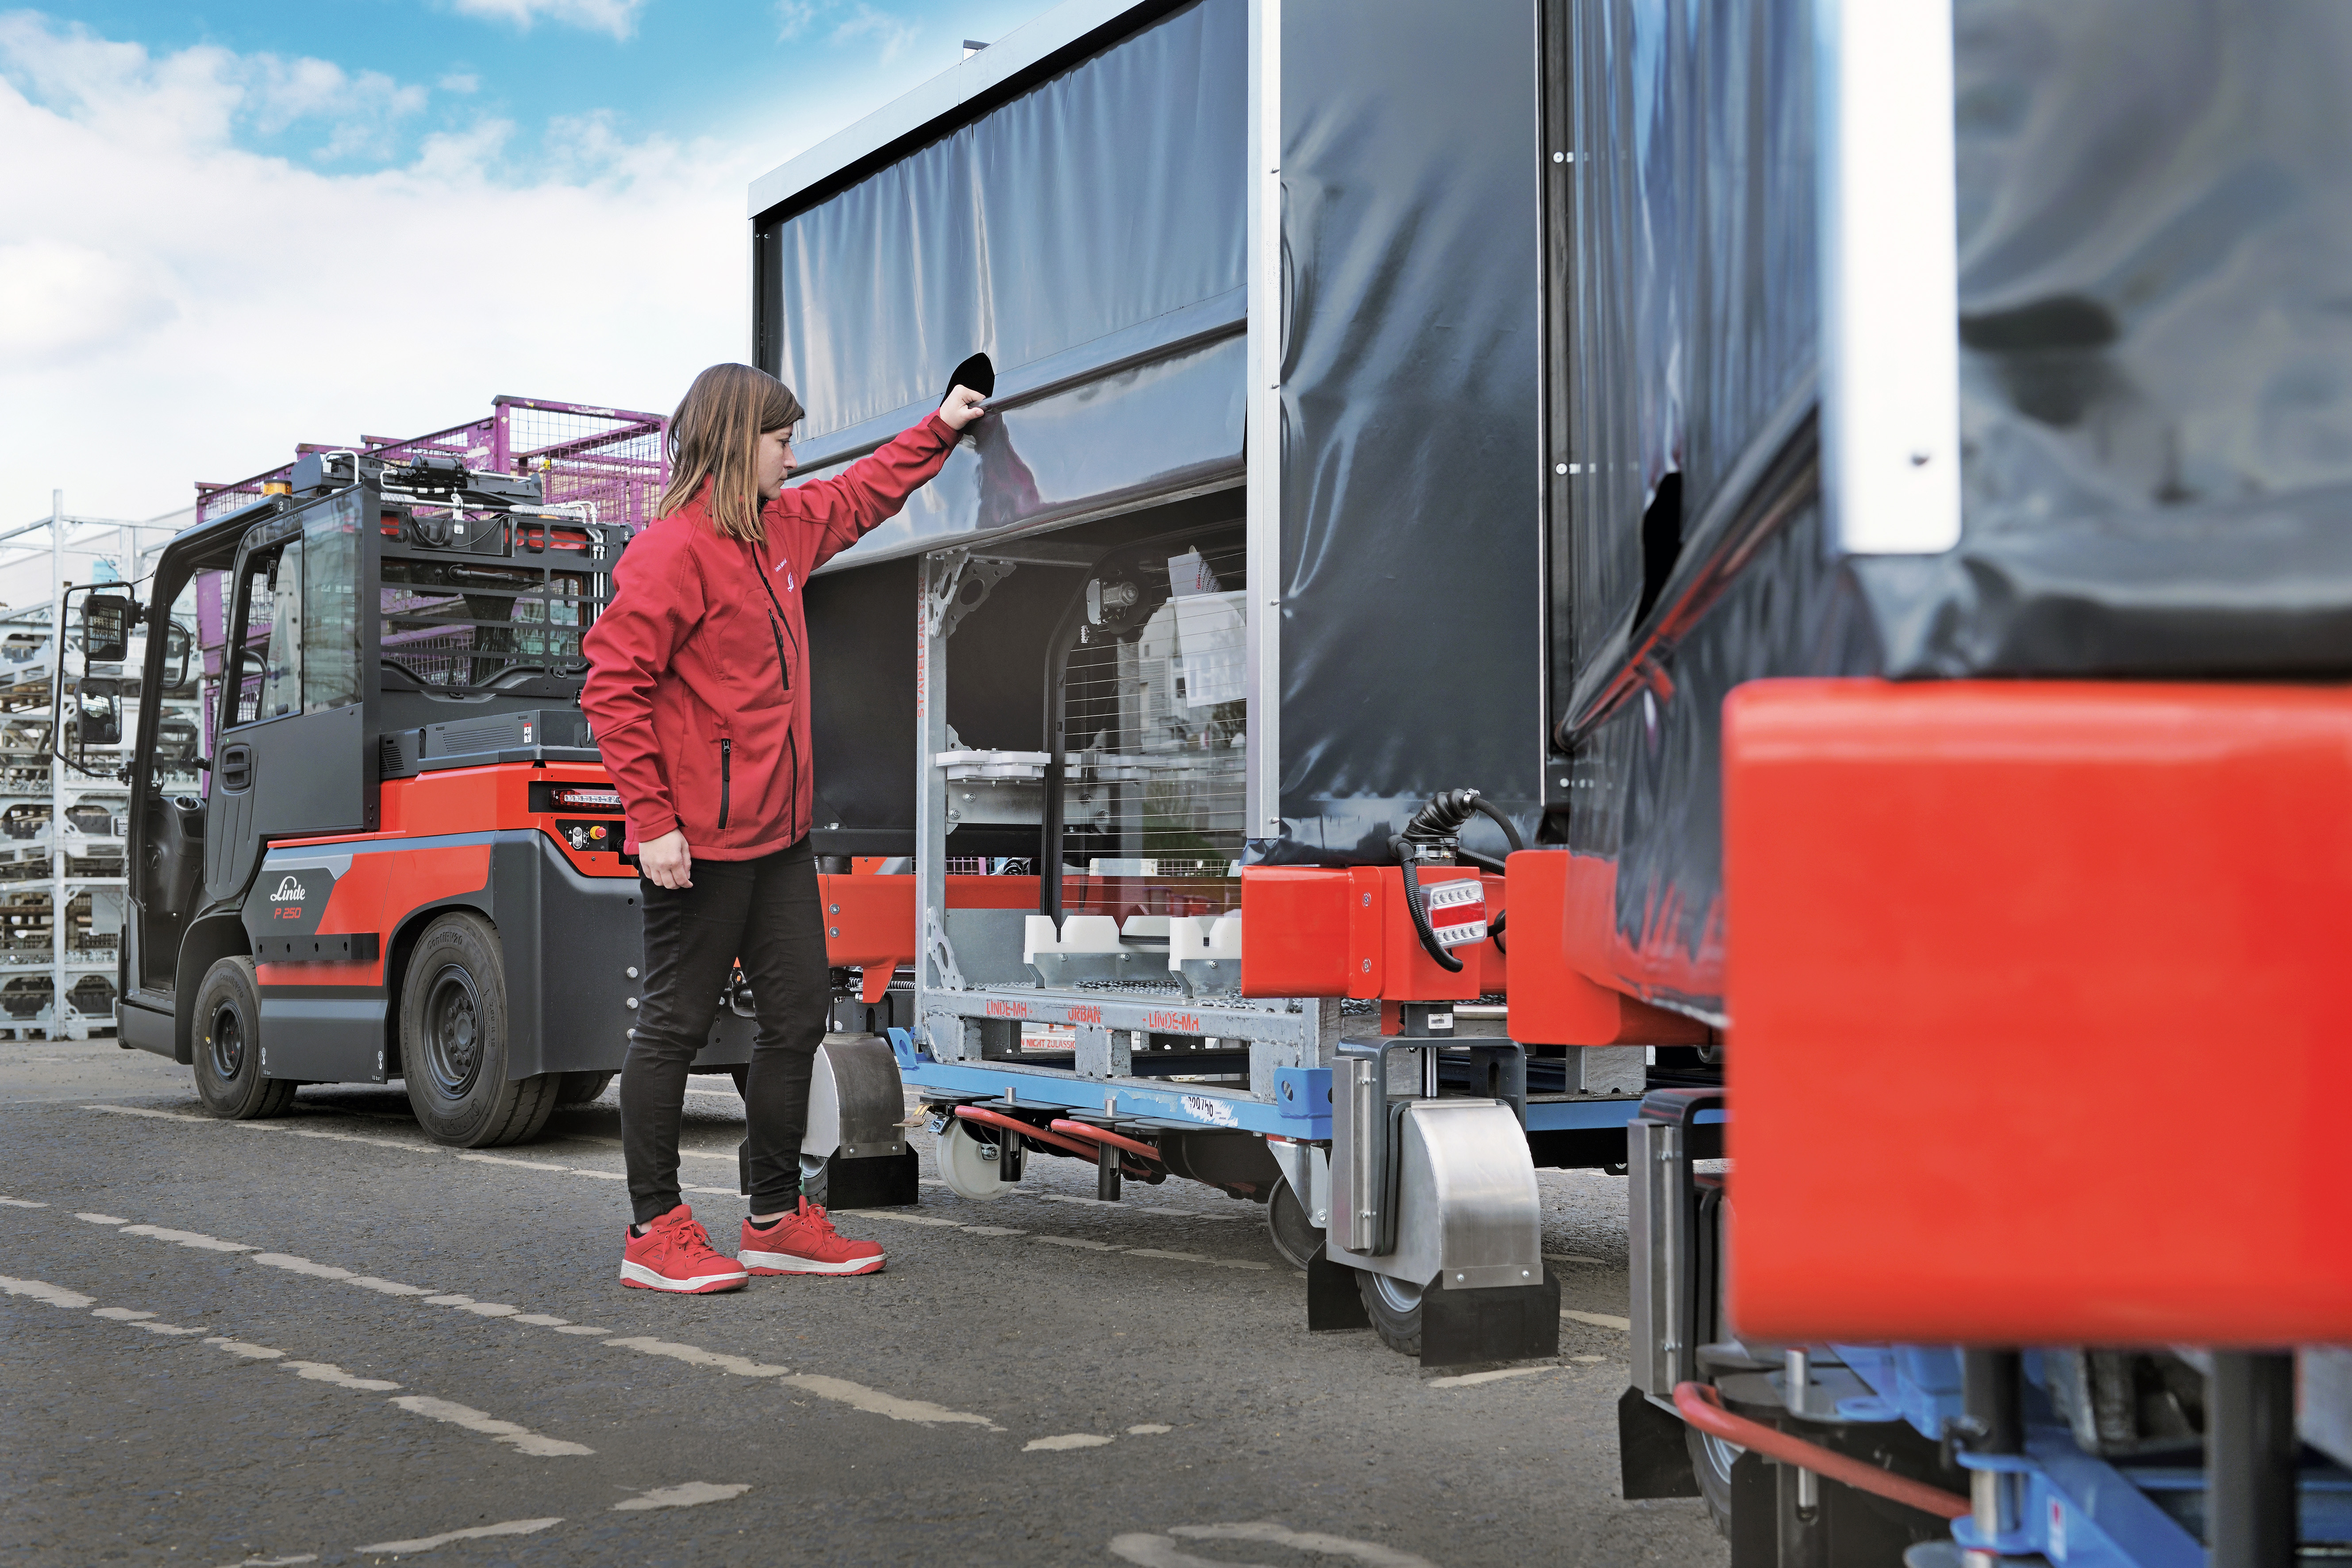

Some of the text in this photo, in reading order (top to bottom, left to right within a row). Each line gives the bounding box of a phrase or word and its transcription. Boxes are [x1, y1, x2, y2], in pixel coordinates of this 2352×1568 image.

[270, 876, 305, 902] Linde
[274, 907, 302, 919] P 250
[986, 1000, 1027, 1018] LINDE-MH
[1068, 1005, 1101, 1023] URBAN
[1149, 1011, 1199, 1032] LINDE-MH
[1026, 1039, 1045, 1048] NICHT
[667, 1216, 683, 1226] Linde
